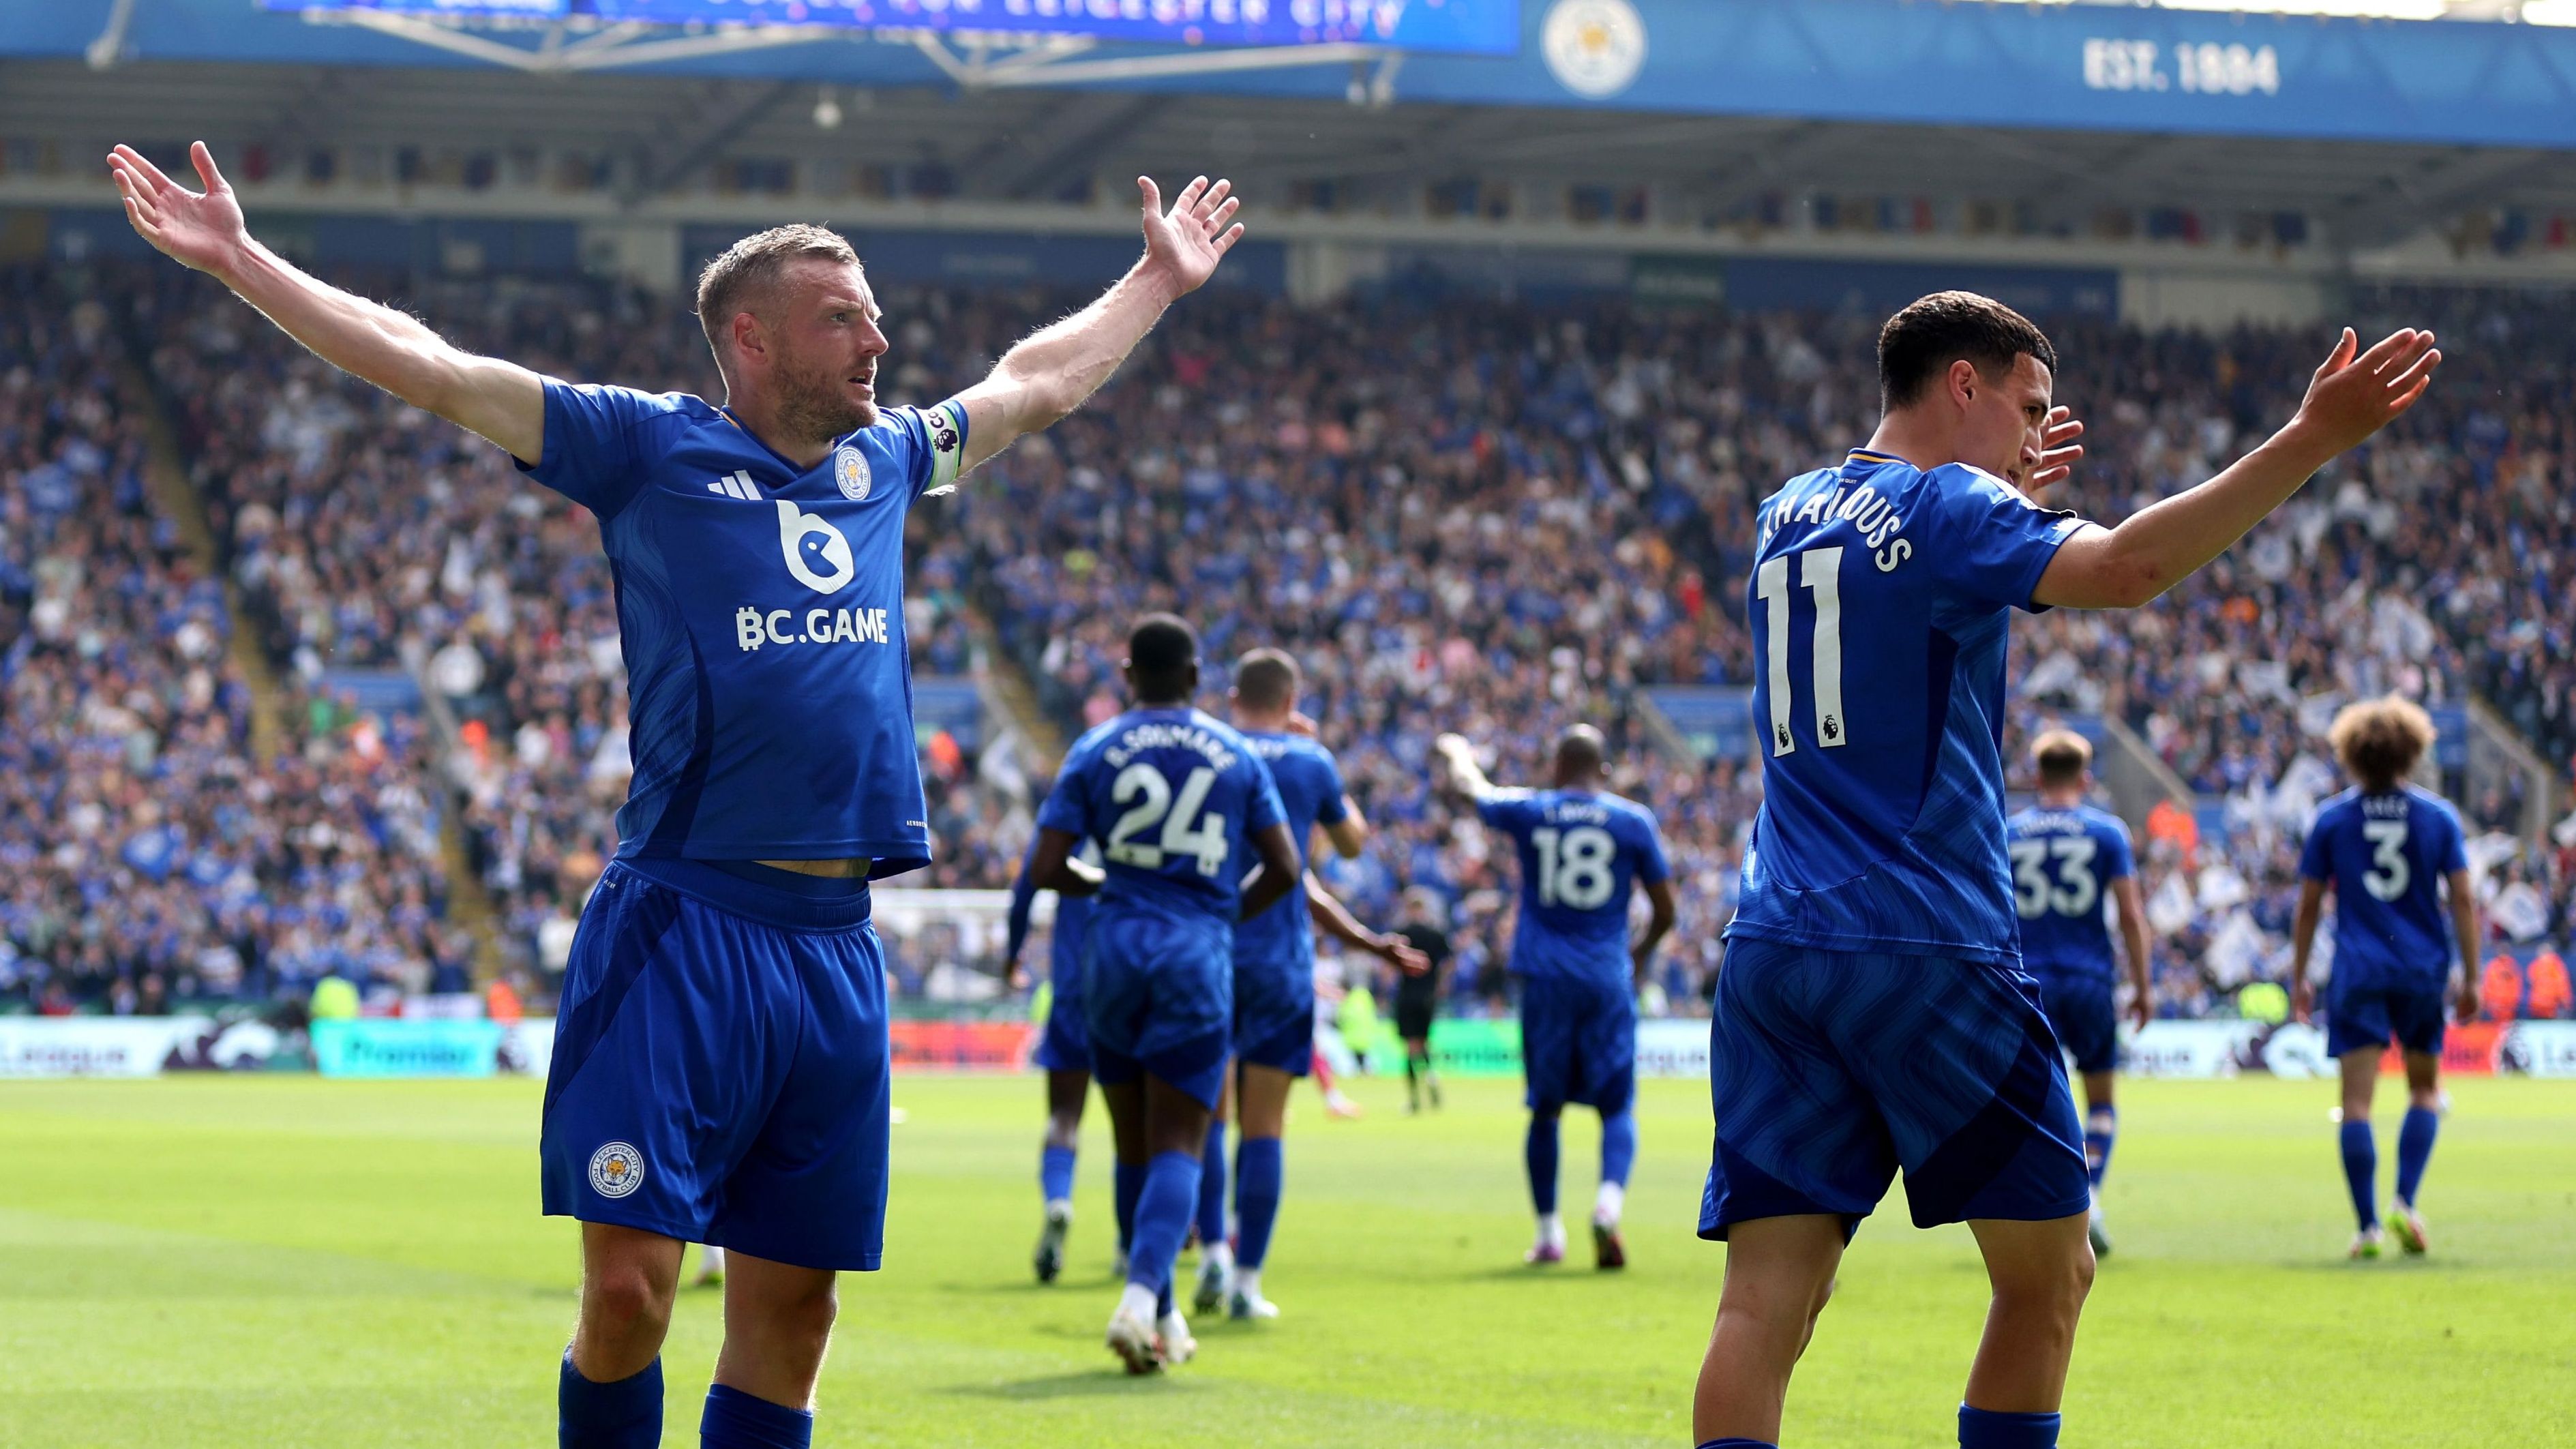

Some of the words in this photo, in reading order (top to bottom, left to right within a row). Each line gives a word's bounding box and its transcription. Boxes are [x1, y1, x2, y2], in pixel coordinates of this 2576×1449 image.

[2084, 38, 2170, 93] EST.
[2174, 42, 2281, 96] 1884
[1757, 546, 1846, 758] 11
[1105, 762, 1227, 878] 24
[2361, 819, 2410, 902] 3
[1532, 826, 1617, 910] 18
[2010, 838, 2098, 919] 33
[593, 1168, 620, 1193] FOOTBALL
[620, 1176, 637, 1191] CLUB
[595, 1146, 631, 1165] LEICESTER
[630, 1155, 638, 1172] CITY
